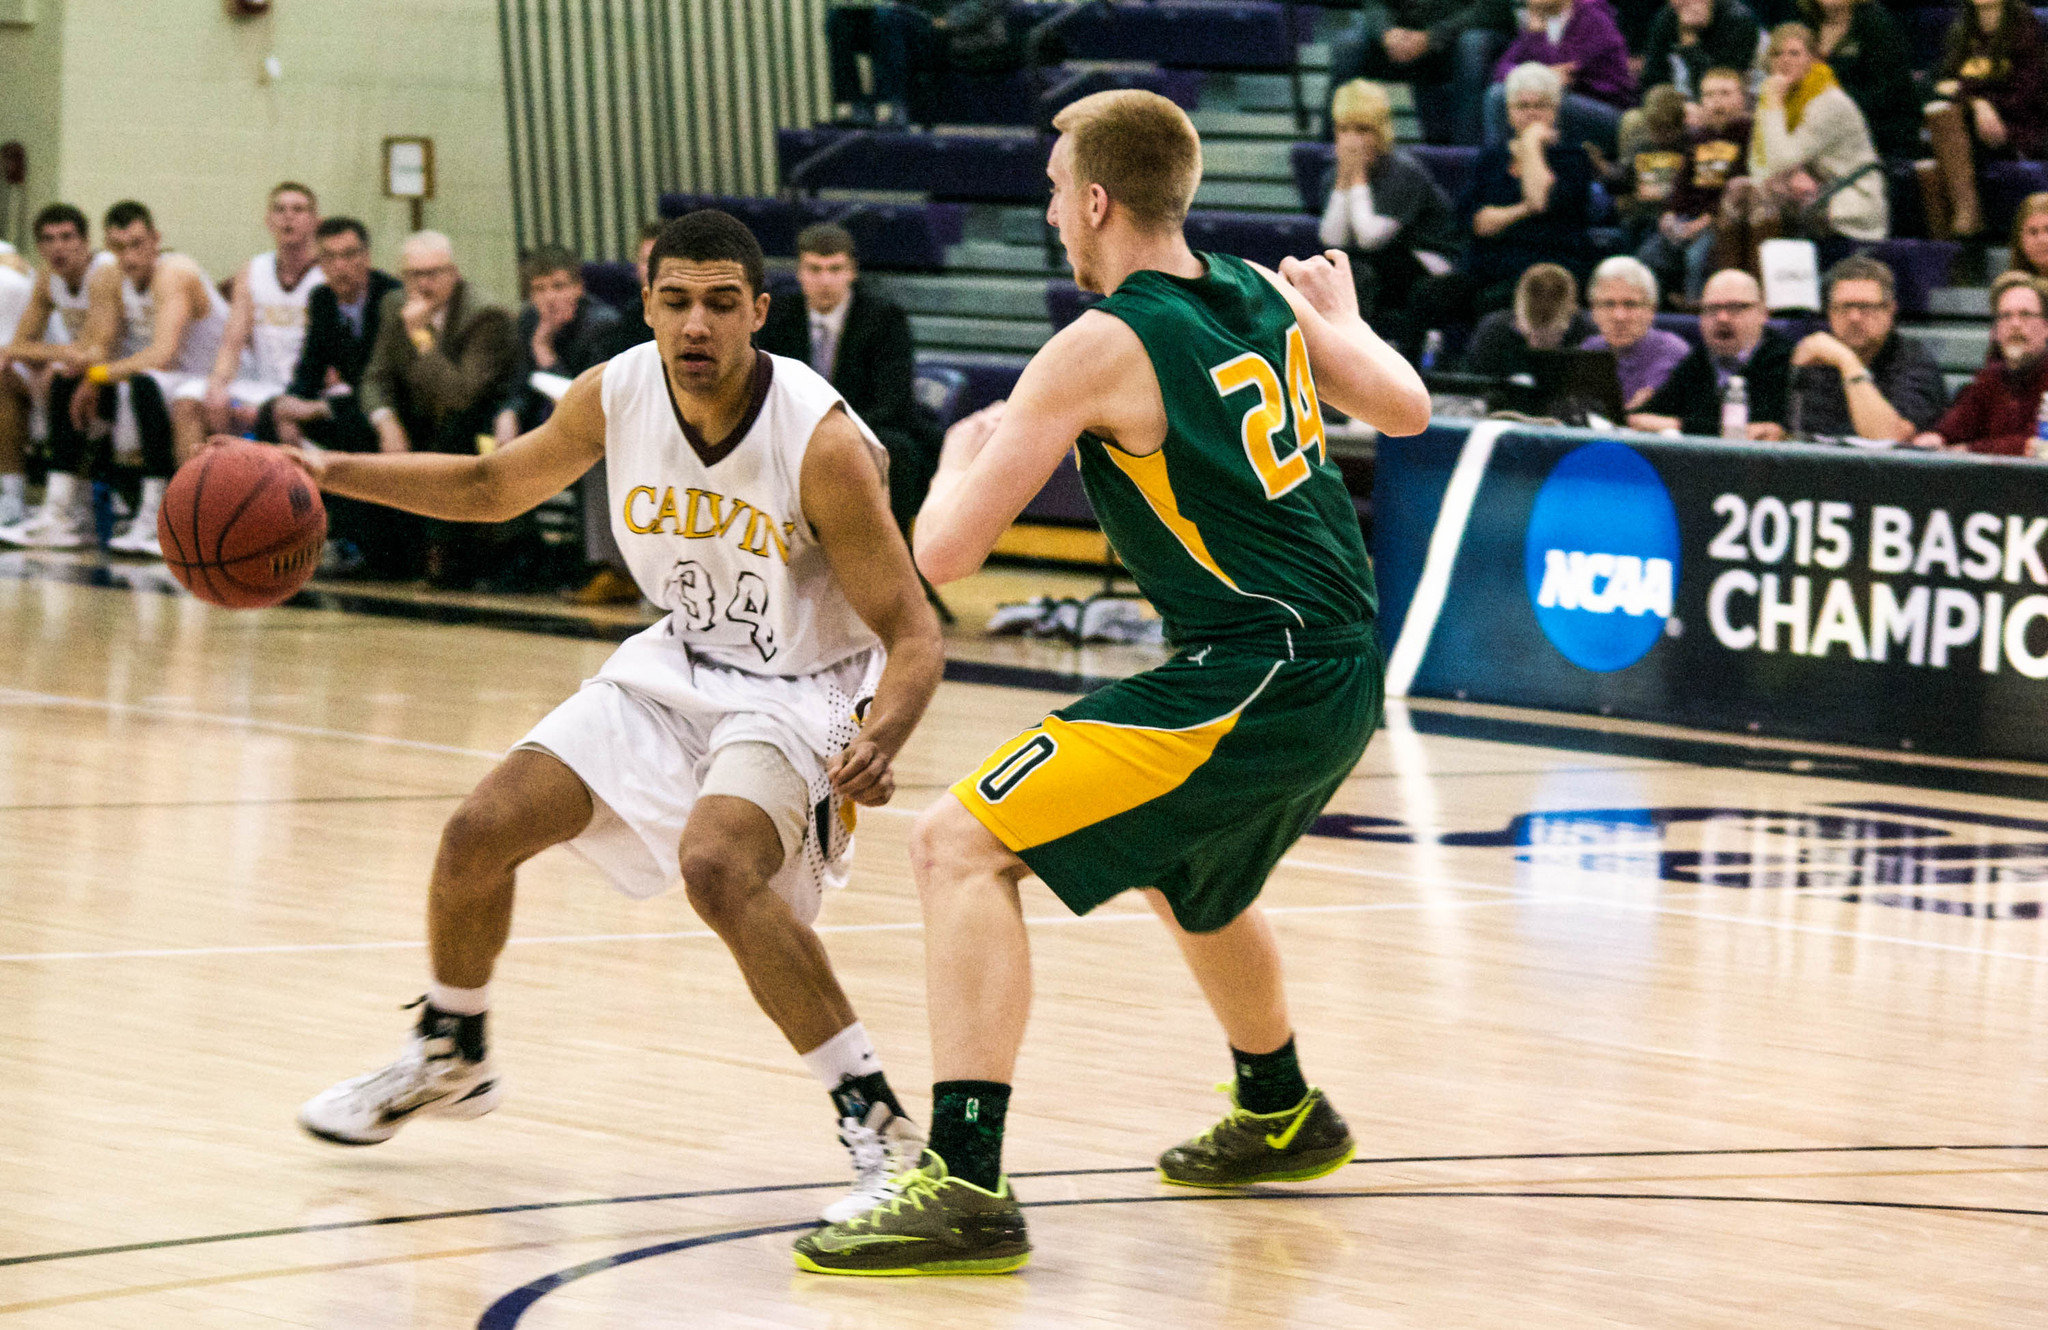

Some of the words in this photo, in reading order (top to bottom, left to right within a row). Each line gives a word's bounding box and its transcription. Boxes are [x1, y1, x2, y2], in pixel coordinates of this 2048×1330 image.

[1209, 321, 1327, 500] 24
[623, 485, 796, 566] CALVIN
[1706, 493, 1853, 569] 2015
[1869, 504, 2048, 586] BASK
[1537, 548, 1673, 619] NCAA
[1706, 568, 2048, 680] CHAMPIO
